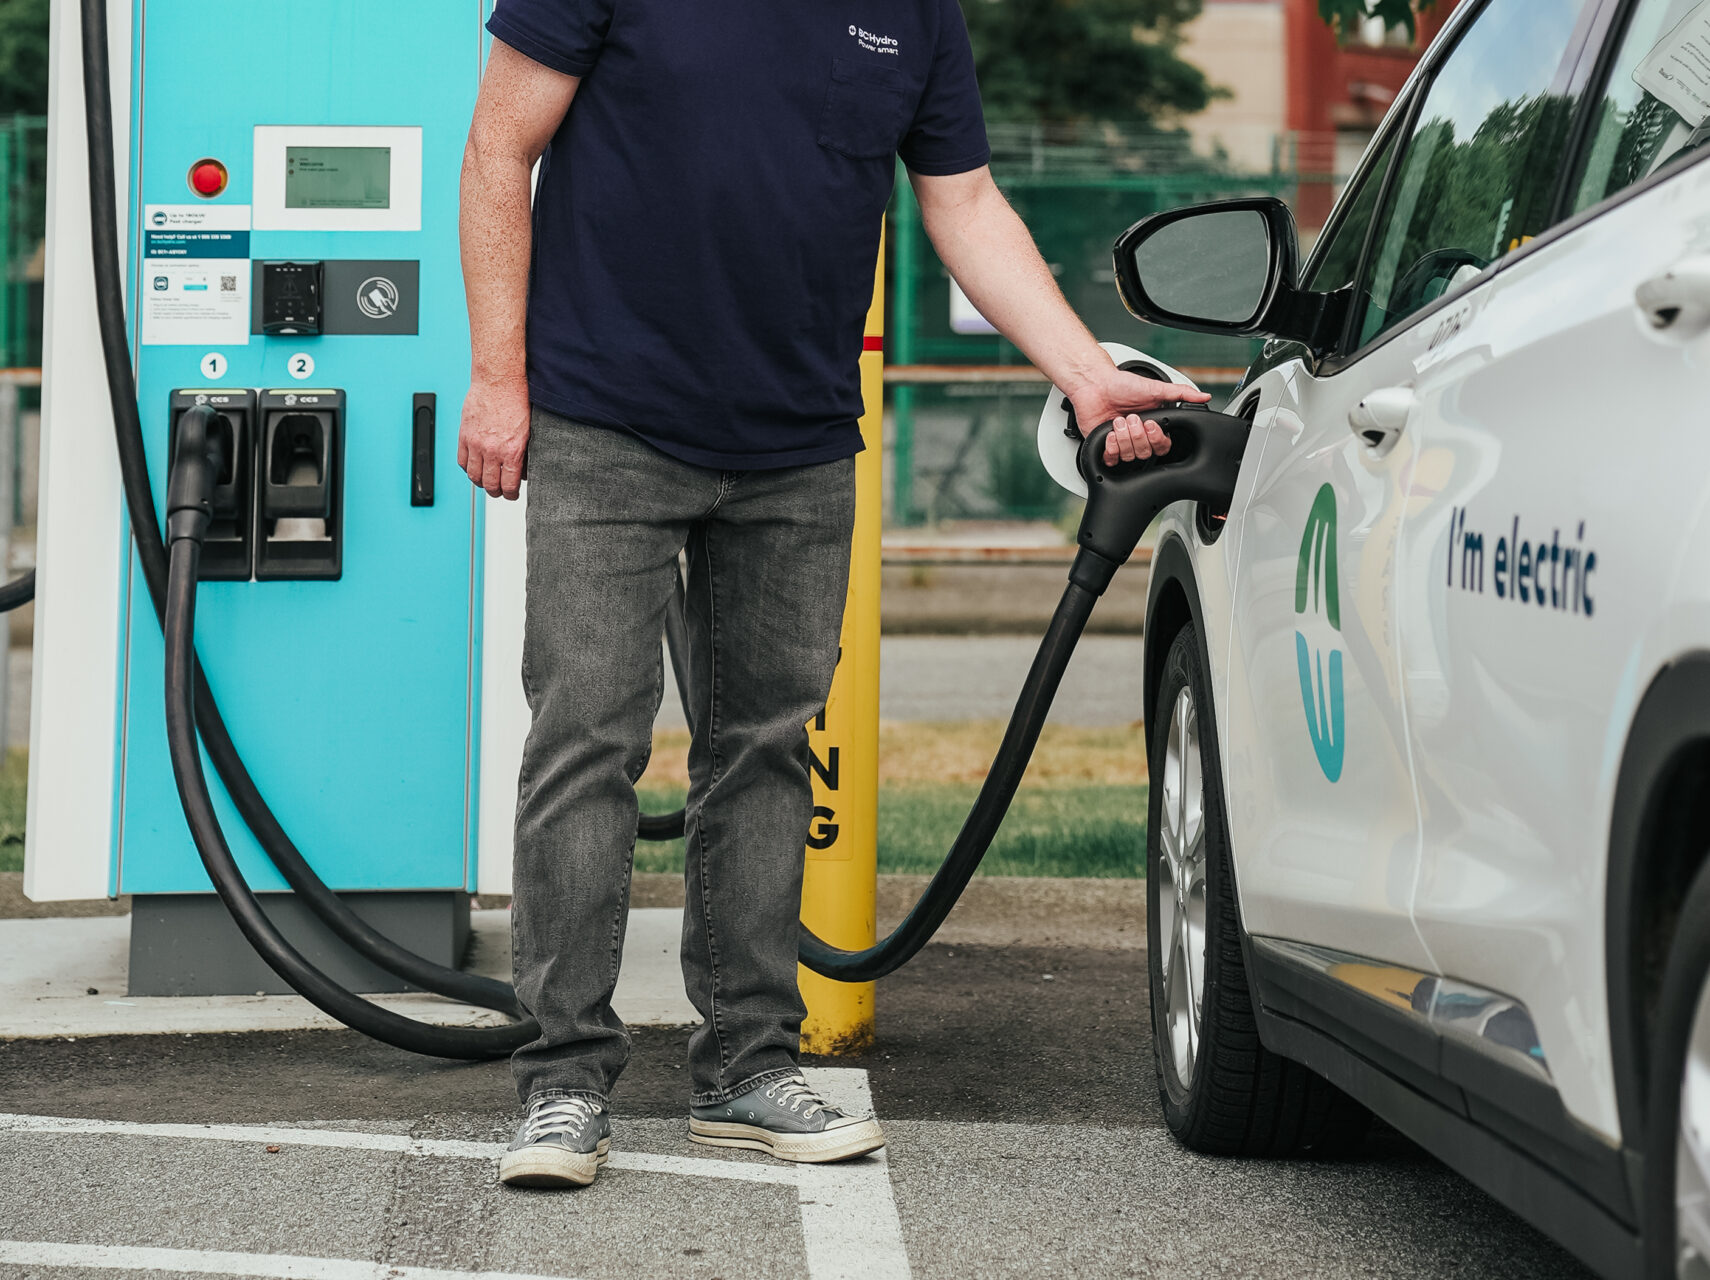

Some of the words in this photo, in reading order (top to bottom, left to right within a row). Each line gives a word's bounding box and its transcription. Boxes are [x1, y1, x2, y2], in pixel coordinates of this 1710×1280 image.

[858, 38, 877, 52] Power
[877, 46, 899, 56] smart
[209, 359, 217, 373] 1
[296, 359, 306, 373] 2
[1447, 505, 1484, 595] I'm
[1493, 515, 1597, 619] electric
